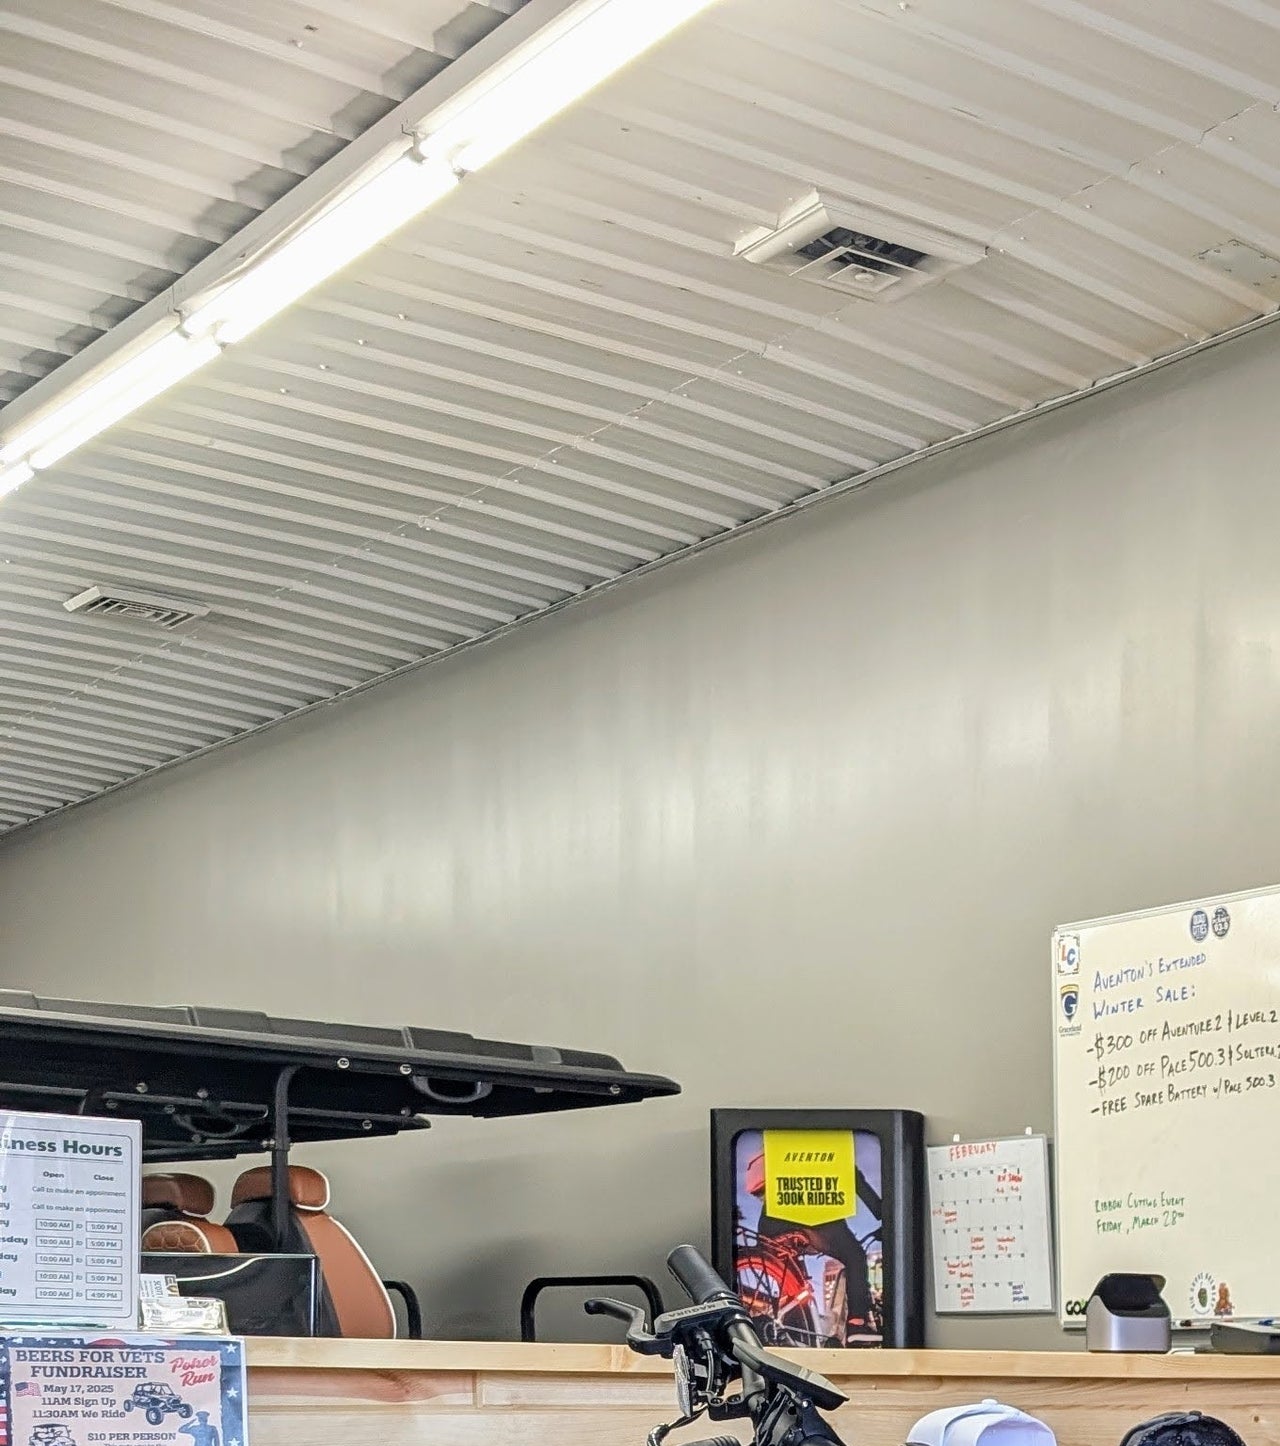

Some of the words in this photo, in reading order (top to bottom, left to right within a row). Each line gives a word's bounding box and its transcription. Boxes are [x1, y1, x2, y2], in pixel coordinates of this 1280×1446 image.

[1093, 998, 1144, 1019] WINTER
[1156, 985, 1196, 1003] SALE:
[1139, 1028, 1158, 1044] OFF
[1136, 1062, 1155, 1077] OFF
[1134, 1091, 1163, 1109] SPARE
[1167, 1083, 1207, 1102] BATTERY
[63, 1140, 123, 1157] Hours
[949, 1142, 997, 1161] FEBRUARY
[784, 1152, 835, 1162] AVENTON
[776, 1177, 823, 1191] TRUSTED
[825, 1177, 839, 1191] BY
[777, 1192, 805, 1206] 300K
[807, 1192, 845, 1206] RIDERS
[16, 1350, 74, 1363] BEERS
[79, 1351, 114, 1363] FOR
[118, 1351, 165, 1363] VETS
[31, 1366, 147, 1378] FUNDRAISER
[180, 1371, 215, 1386] Run
[44, 1385, 67, 1395] May
[87, 1385, 114, 1393] 2025
[41, 1397, 71, 1406] 11AM
[74, 1397, 98, 1408] Sign
[101, 1397, 116, 1408] Up
[81, 1410, 98, 1418] We
[101, 1410, 125, 1418] Ride
[109, 1433, 130, 1441] PER
[133, 1433, 176, 1441] PERSON
